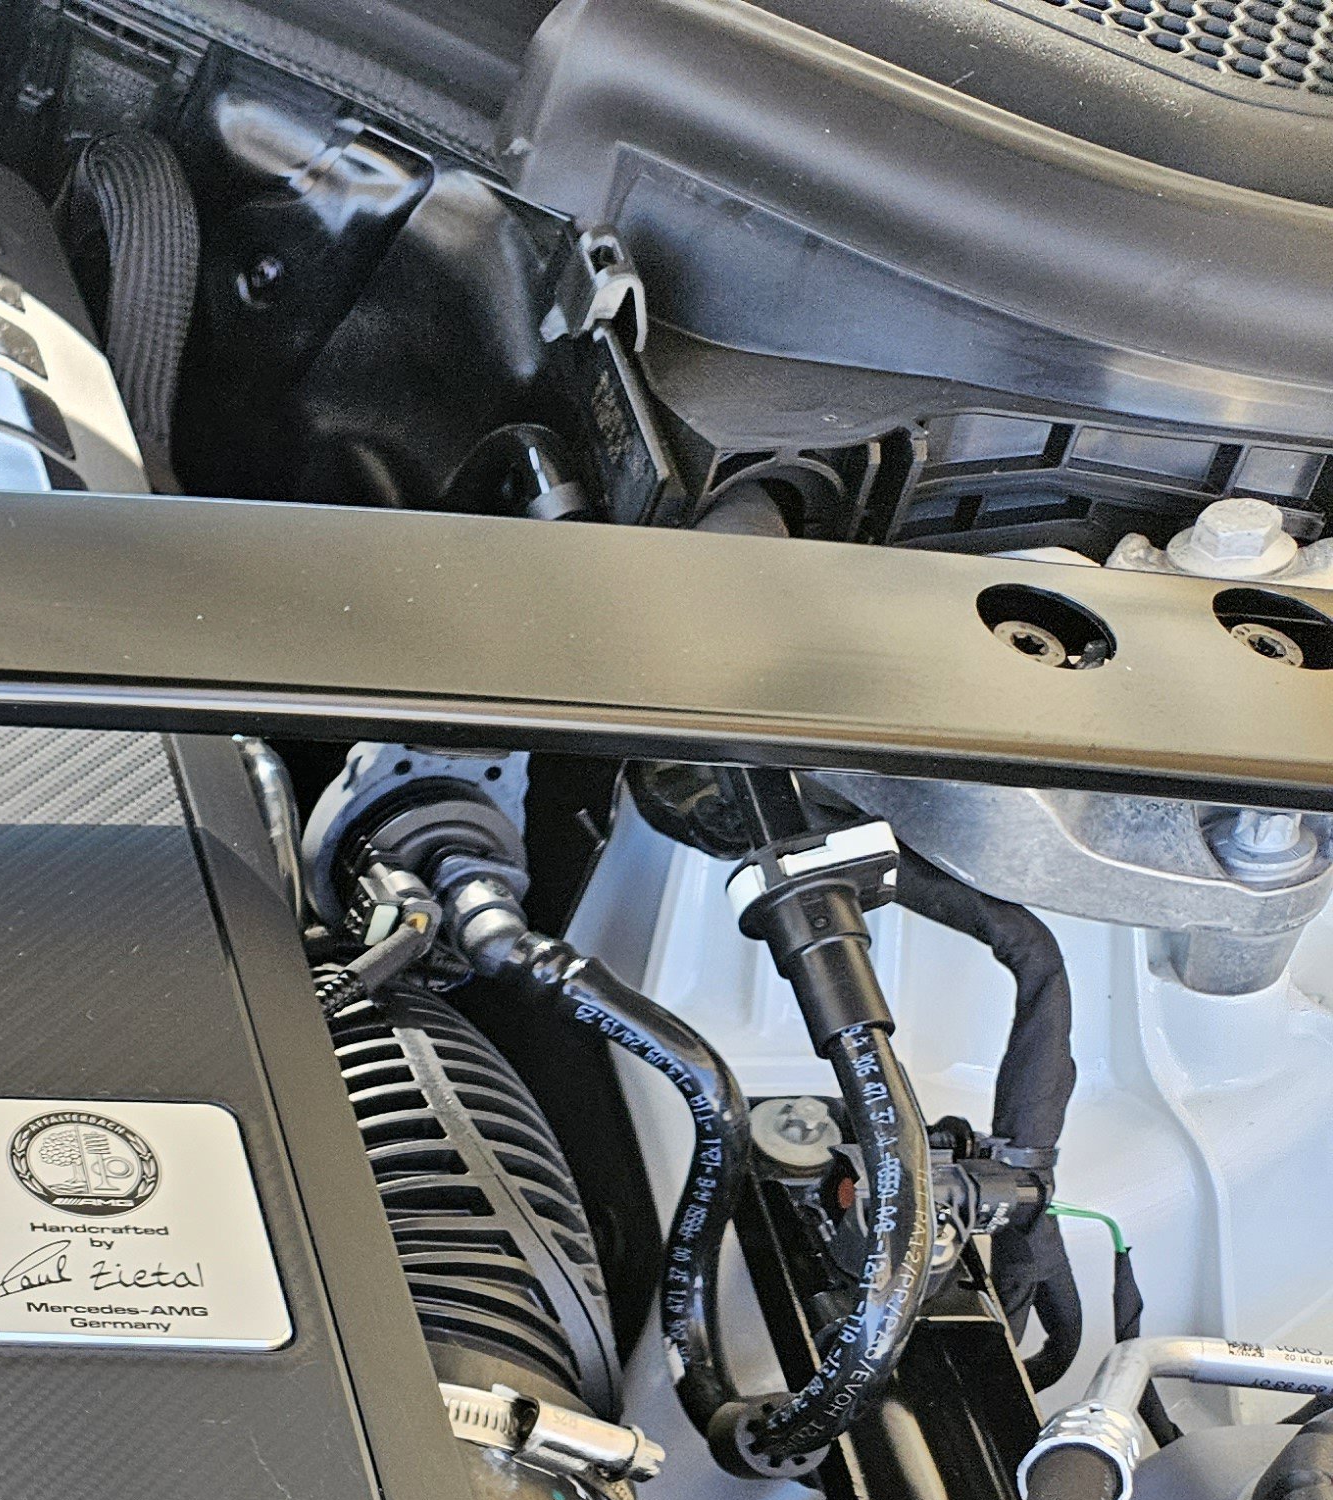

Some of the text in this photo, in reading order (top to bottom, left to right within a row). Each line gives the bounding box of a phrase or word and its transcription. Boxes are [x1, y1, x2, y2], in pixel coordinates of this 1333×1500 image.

[29, 1113, 126, 1135] AFFALTERBACH
[30, 1223, 169, 1236] Handcrafted
[89, 1238, 115, 1250] by
[26, 1302, 209, 1317] Mercedes-AMG
[70, 1318, 172, 1332] Germany
